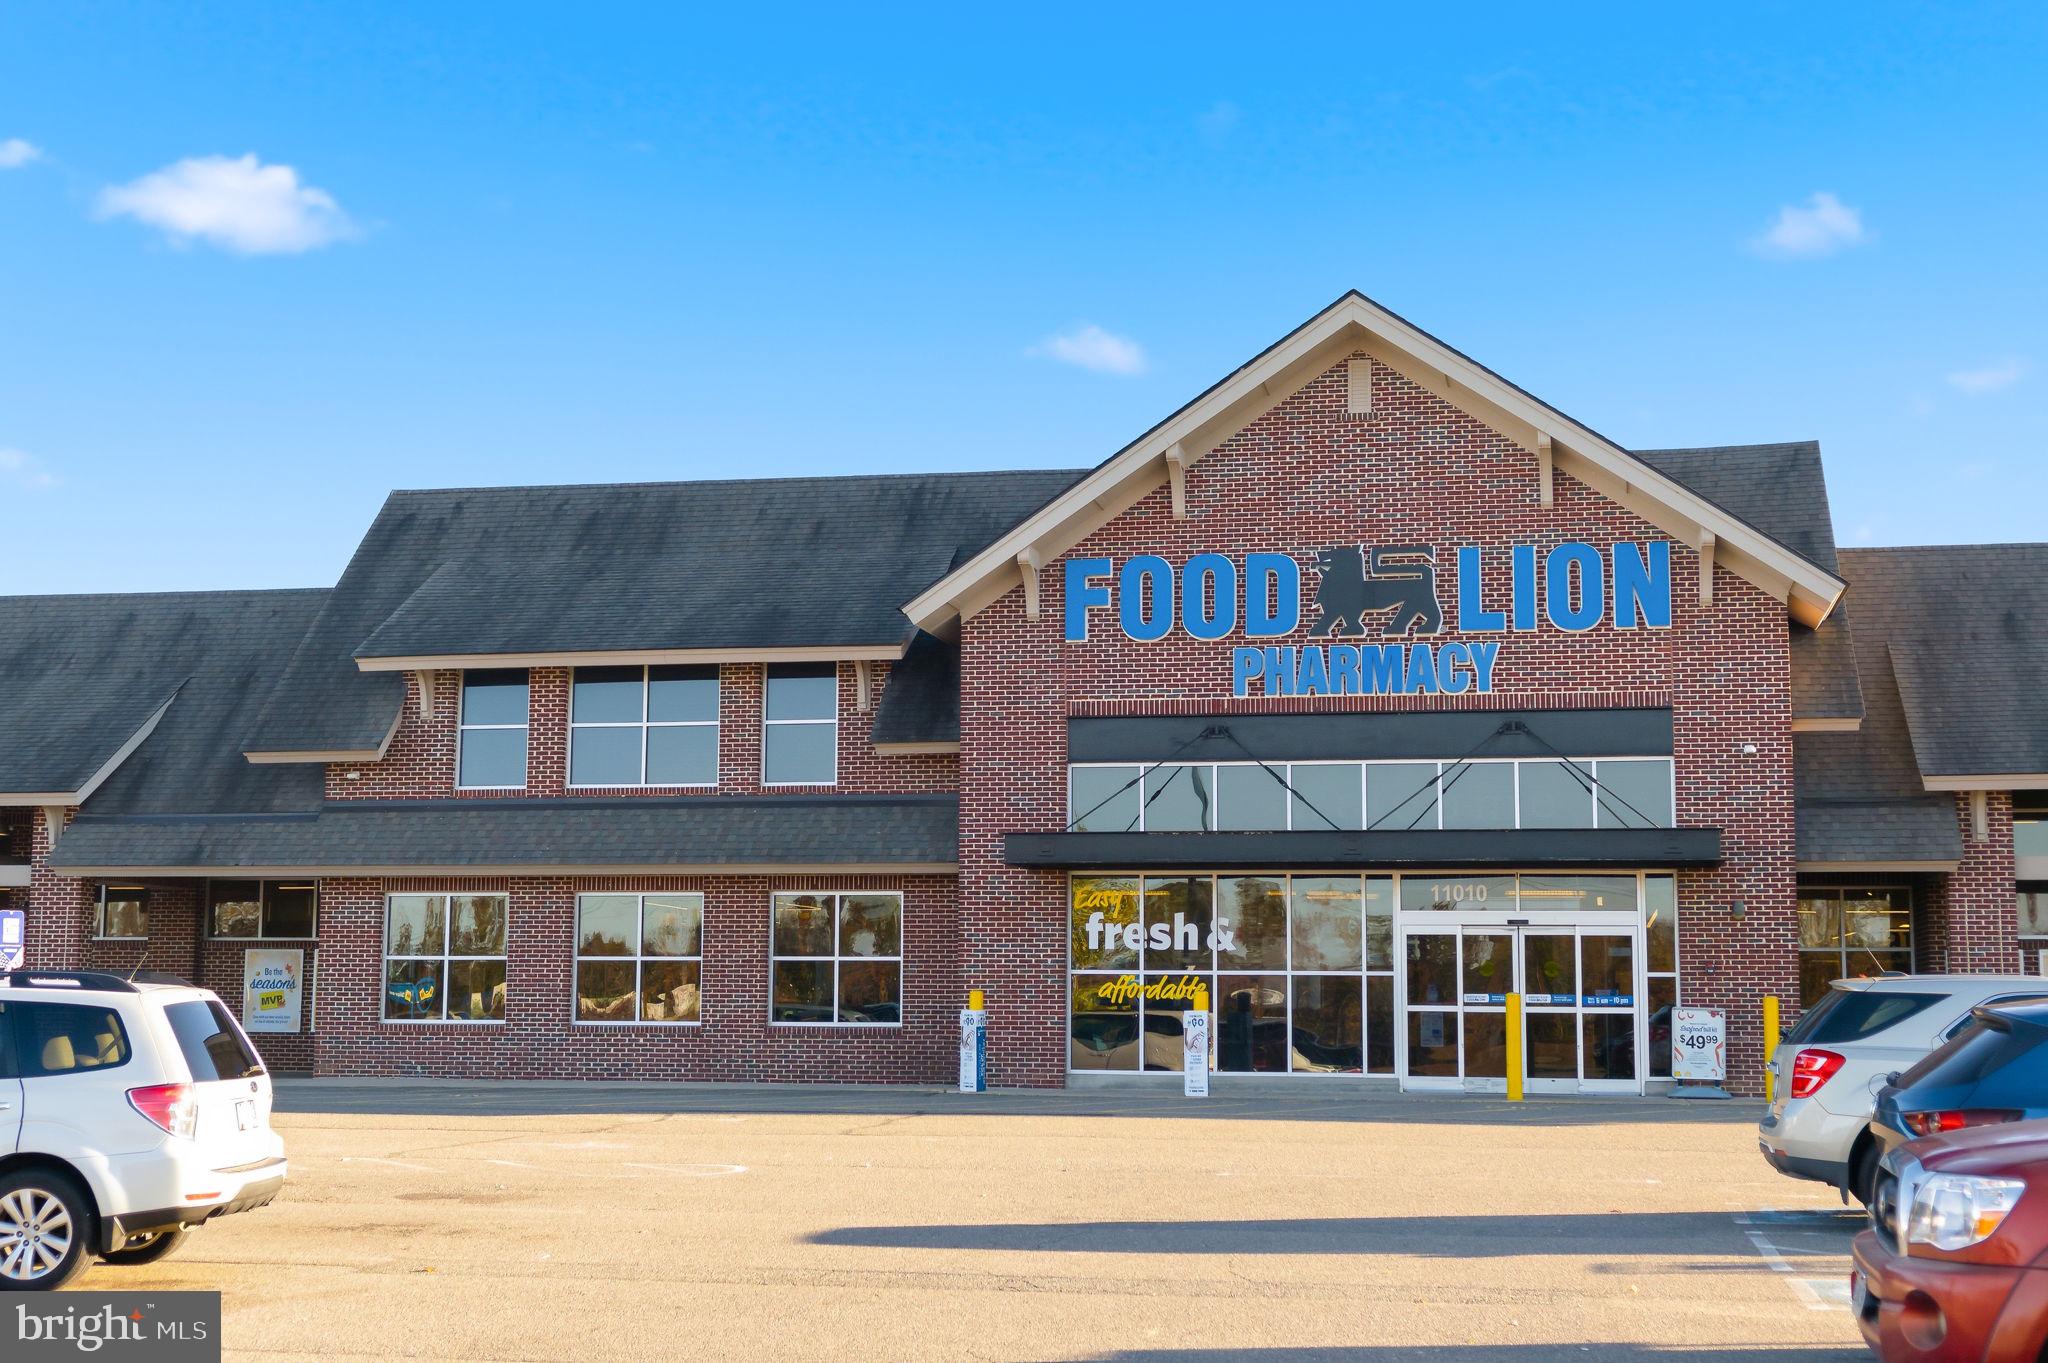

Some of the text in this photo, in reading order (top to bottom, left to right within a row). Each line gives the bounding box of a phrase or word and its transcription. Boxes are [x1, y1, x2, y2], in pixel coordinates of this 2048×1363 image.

[1064, 541, 1673, 643] FOOD LION
[1232, 641, 1500, 697] PHARMACY
[1431, 884, 1488, 902] 11010
[1085, 911, 1237, 951] fresh &
[264, 967, 273, 976] Be
[261, 994, 283, 1006] MVP
[1098, 974, 1207, 1004] affordable
